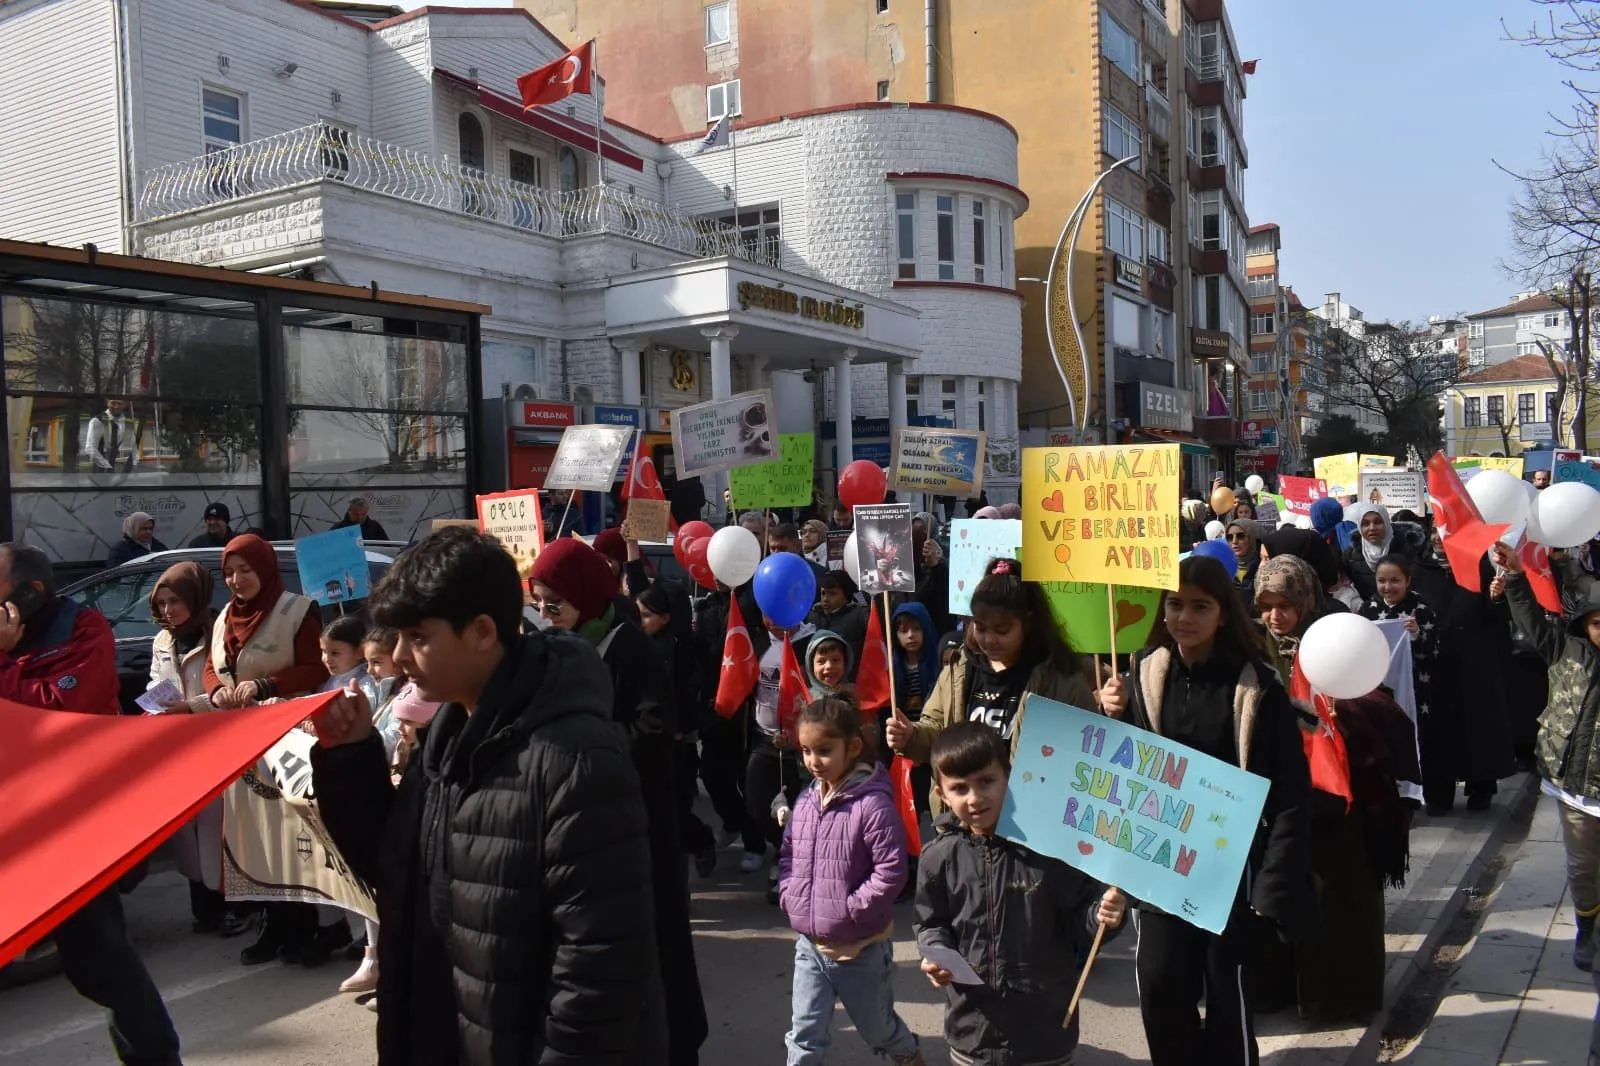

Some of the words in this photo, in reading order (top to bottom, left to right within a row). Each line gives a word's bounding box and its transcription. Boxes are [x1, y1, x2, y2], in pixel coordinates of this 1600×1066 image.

[530, 411, 569, 420] AKBANK
[1146, 390, 1179, 414] EZEL
[1044, 448, 1178, 483] RAMAZAN
[490, 500, 525, 520] ORUÇ
[1084, 480, 1158, 511] BİRLİK
[1040, 518, 1076, 541] VE
[1081, 514, 1179, 540] BERABERLİK
[1105, 545, 1172, 570] AYIDIR
[1080, 724, 1107, 758] 11
[1109, 735, 1189, 791] AYIN
[1070, 761, 1195, 834] SULTANI
[1062, 796, 1198, 877] RAMAZAN
